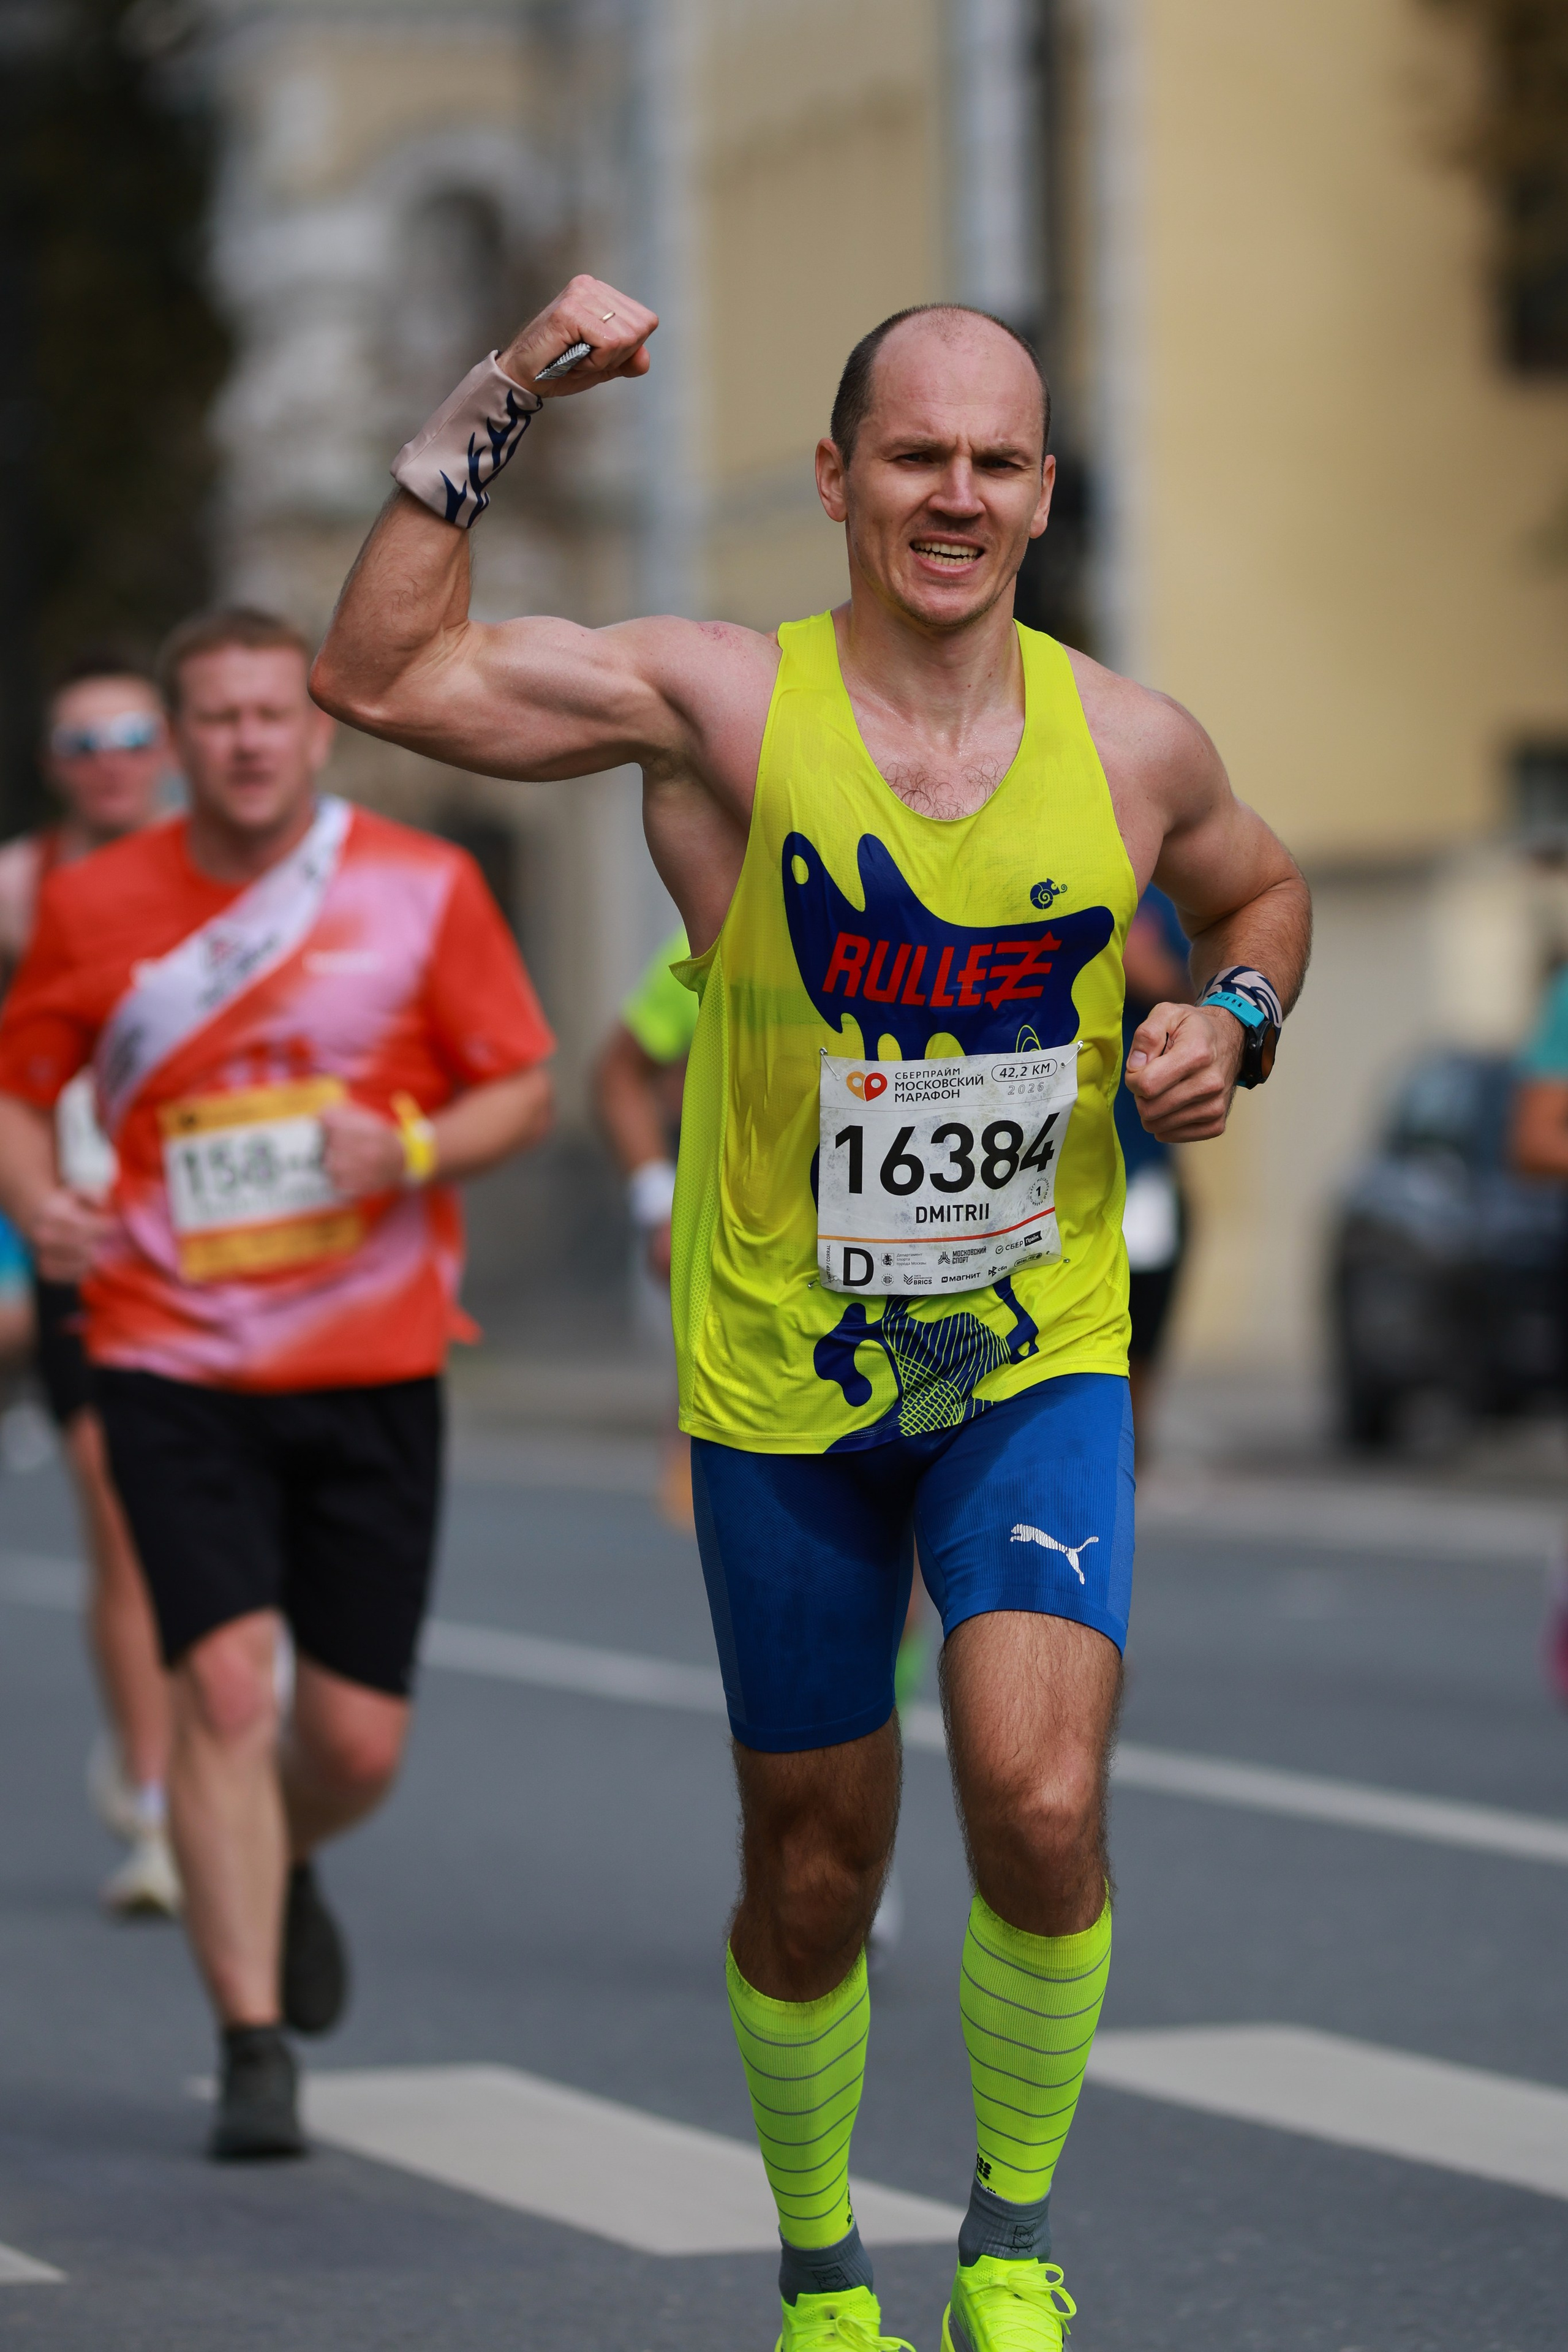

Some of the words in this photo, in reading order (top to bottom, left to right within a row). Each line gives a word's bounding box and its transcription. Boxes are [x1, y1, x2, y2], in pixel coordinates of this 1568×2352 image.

[822, 931, 1062, 1011] RULLEZ
[895, 1068, 960, 1080] СБЕРПРАЙМ
[999, 1066, 1028, 1079] 42,2
[895, 1074, 984, 1091] МОСКОВСКИЙ
[895, 1089, 960, 1102] МАРАФОН
[835, 1112, 1060, 1196] 16384
[1036, 1186, 1041, 1197] 1
[915, 1203, 990, 1224] DMITRII
[1005, 1241, 1023, 1251] СБЕР
[1025, 1235, 1039, 1244] Прайм
[952, 1246, 987, 1257] МОСКОВСКИЙ
[843, 1246, 874, 1287] D
